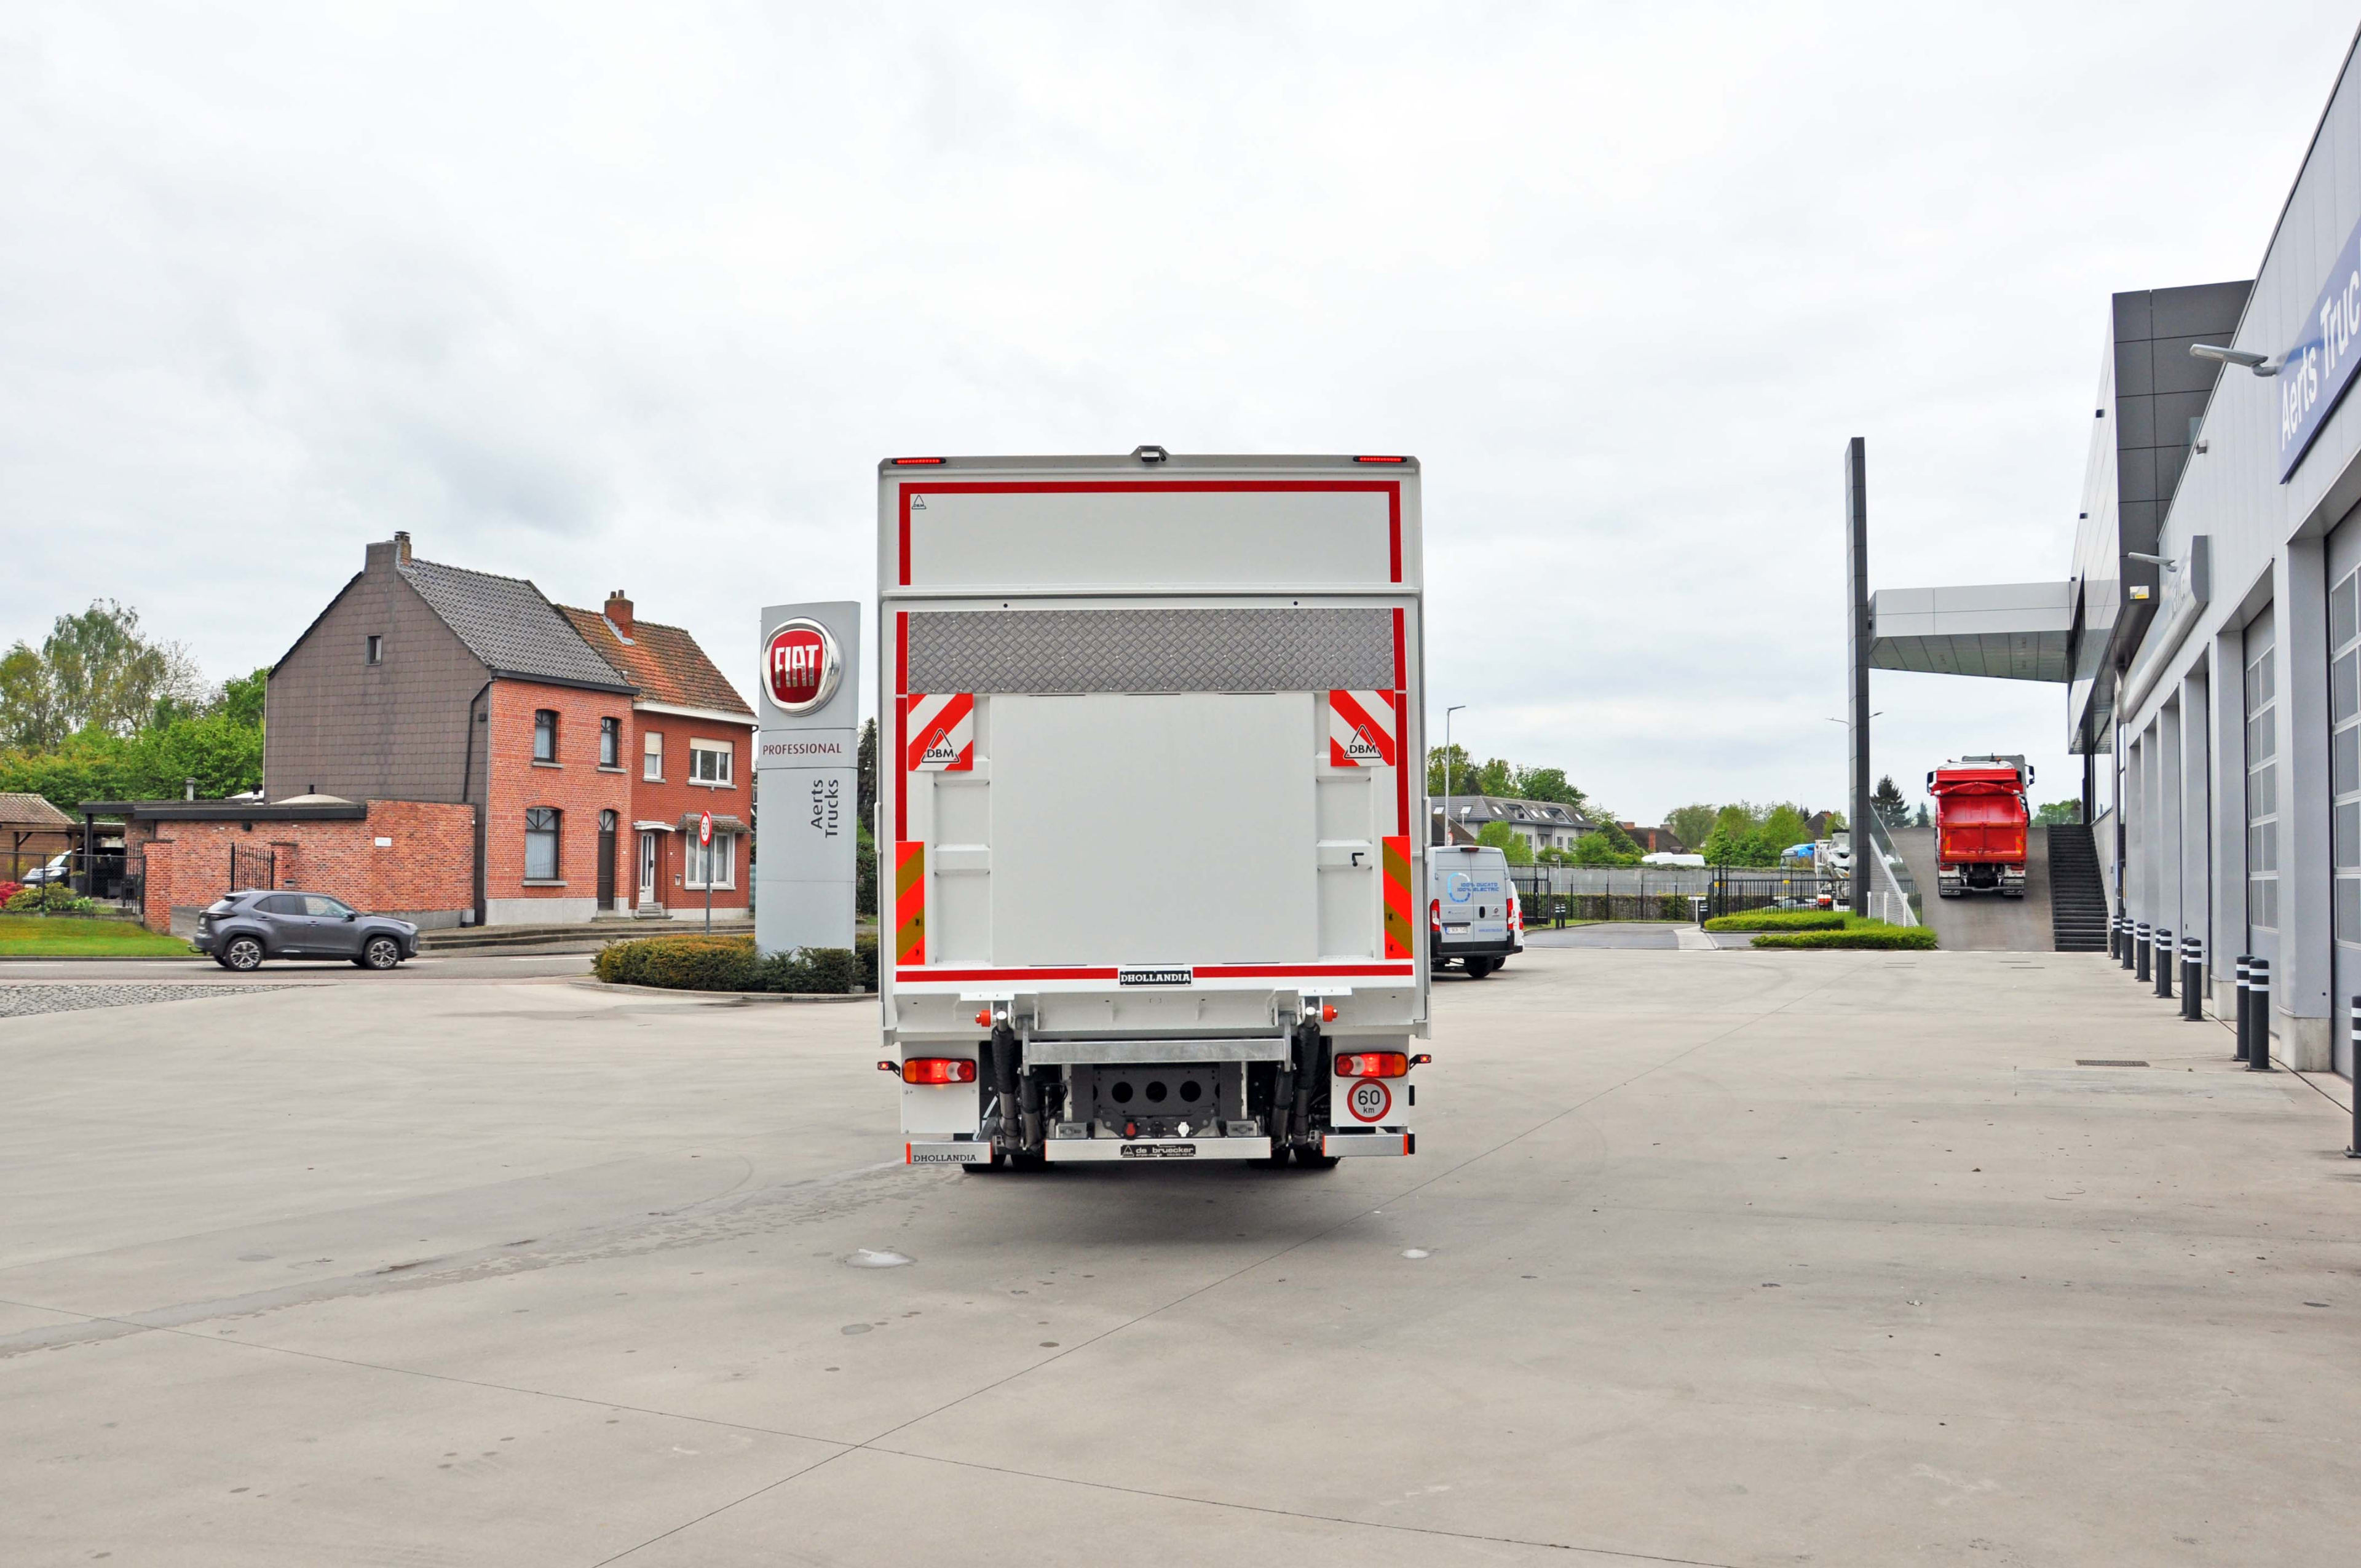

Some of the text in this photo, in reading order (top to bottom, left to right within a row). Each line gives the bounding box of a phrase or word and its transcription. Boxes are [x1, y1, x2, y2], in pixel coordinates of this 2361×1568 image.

[2282, 237, 2361, 452] Aerts Truc
[775, 644, 819, 688] FIAT
[763, 743, 842, 755] PROFESSIONAL
[927, 748, 954, 758] DBM
[1350, 745, 1376, 753] DBM
[811, 780, 823, 830] Aerts
[825, 780, 839, 838] Trucks
[1358, 1090, 1380, 1105] 60
